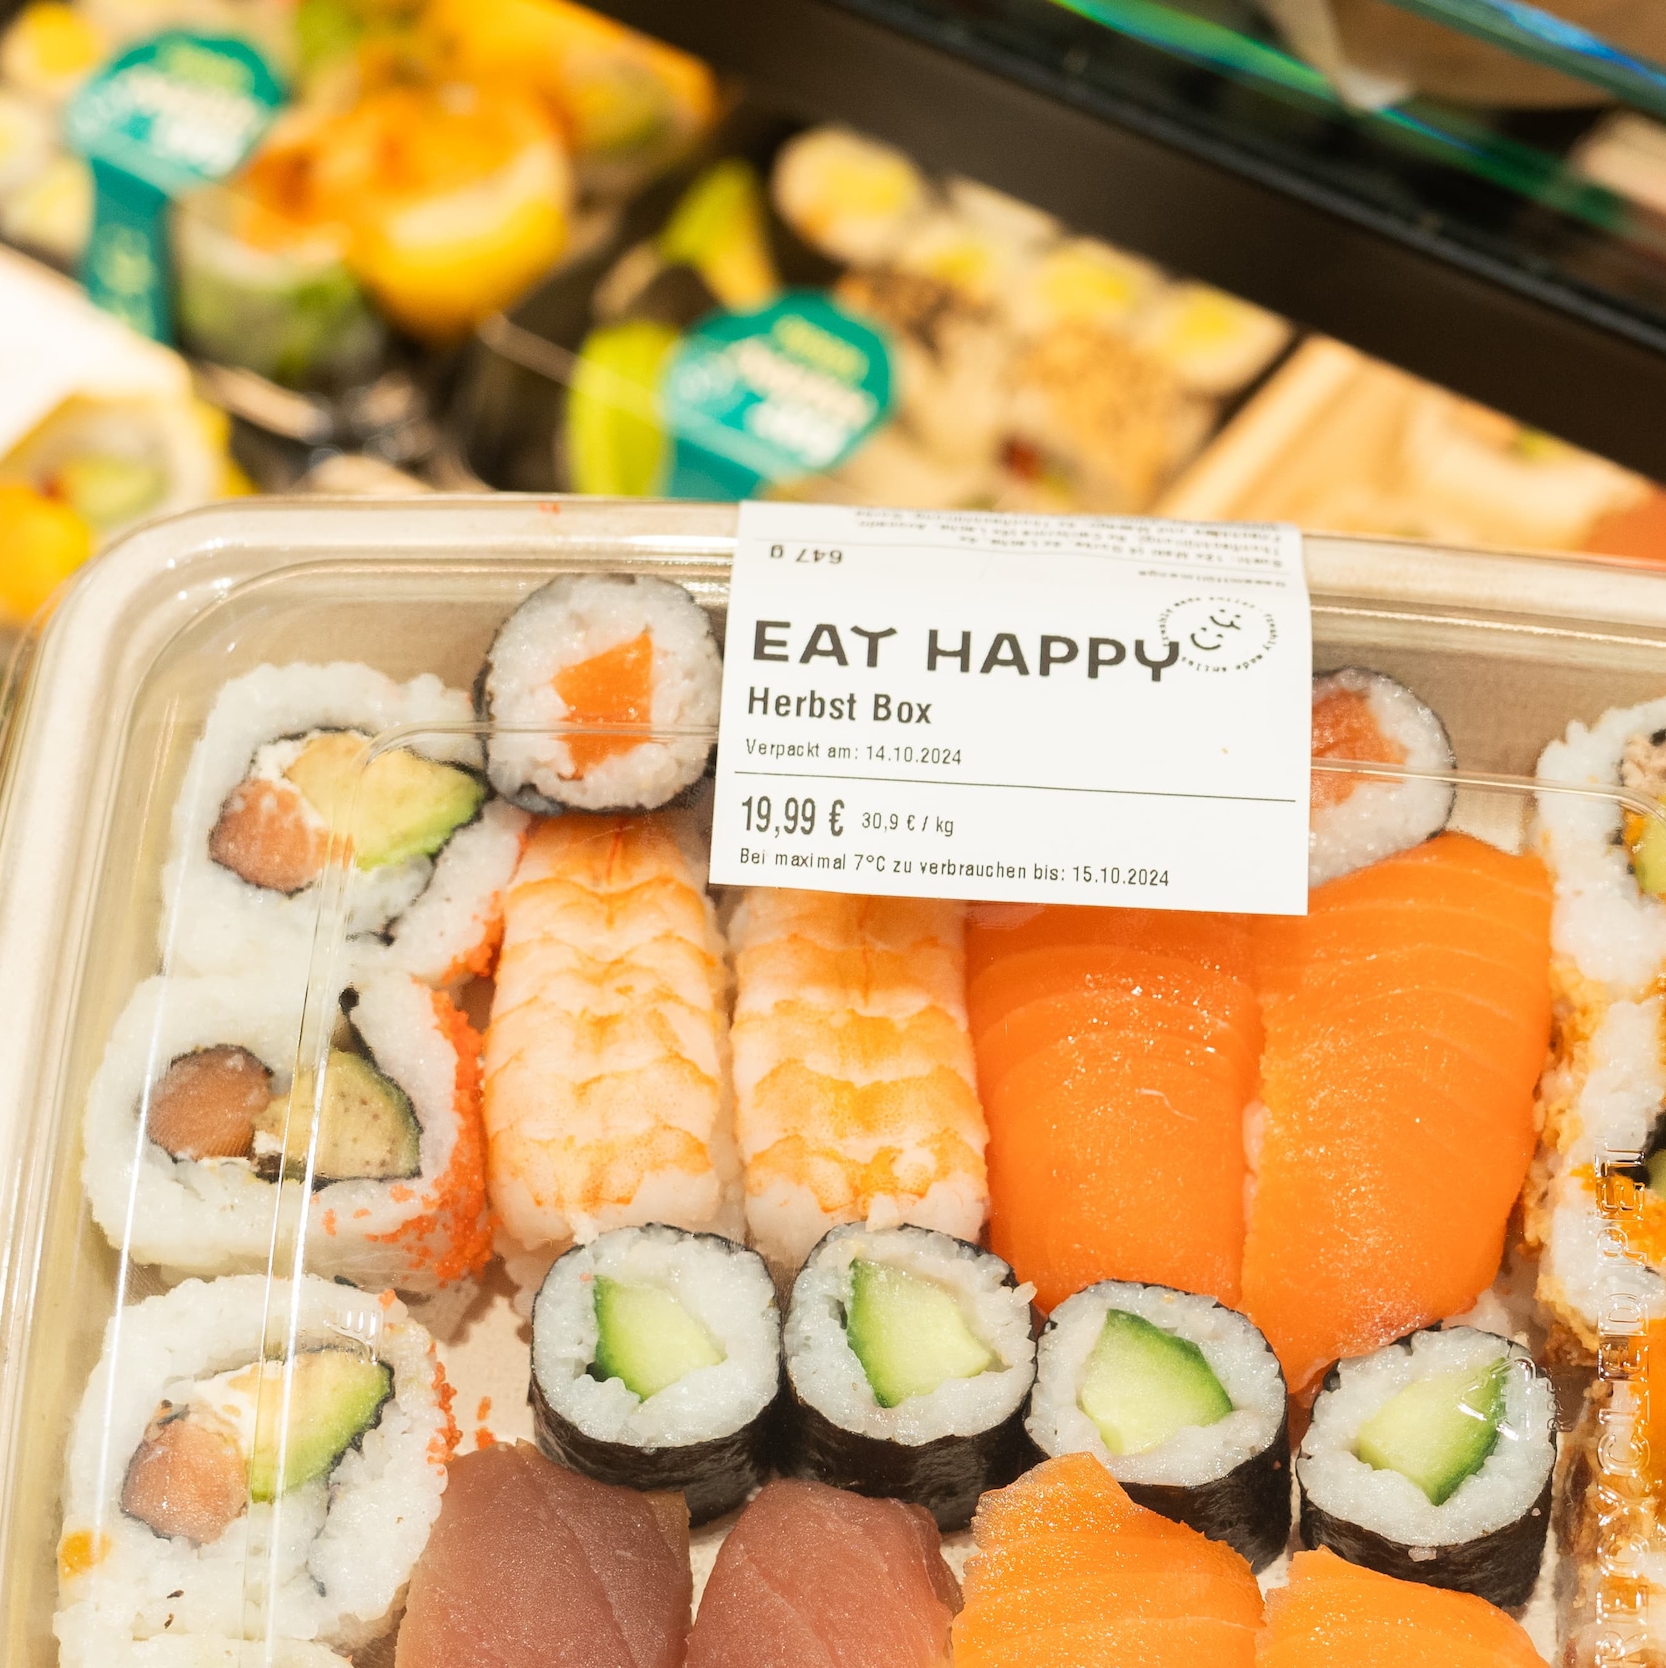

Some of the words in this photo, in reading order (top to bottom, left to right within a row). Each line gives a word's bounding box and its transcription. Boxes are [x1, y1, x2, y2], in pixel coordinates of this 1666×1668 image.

[769, 543, 784, 561] g
[794, 546, 843, 564] 647
[752, 620, 898, 668] EAT
[927, 628, 1180, 682] HAPPY
[747, 686, 857, 722] Herbst
[873, 693, 932, 725] Box
[746, 738, 820, 760] Verpackt
[828, 745, 859, 761] am:
[866, 745, 962, 766] 14.10.2024
[741, 795, 816, 839] 19,99
[829, 800, 845, 837] €
[861, 812, 899, 832] 30,9
[907, 814, 916, 831] €
[936, 815, 955, 837] kg
[739, 848, 766, 866] Bei
[774, 849, 846, 871] maximal
[854, 853, 885, 872] 7°C
[893, 860, 913, 873] zu
[920, 857, 1027, 880] verbrauchen
[1034, 862, 1066, 882] bis:
[1072, 864, 1170, 888] 15.10.2024
[1594, 1137, 1648, 1266] PET
